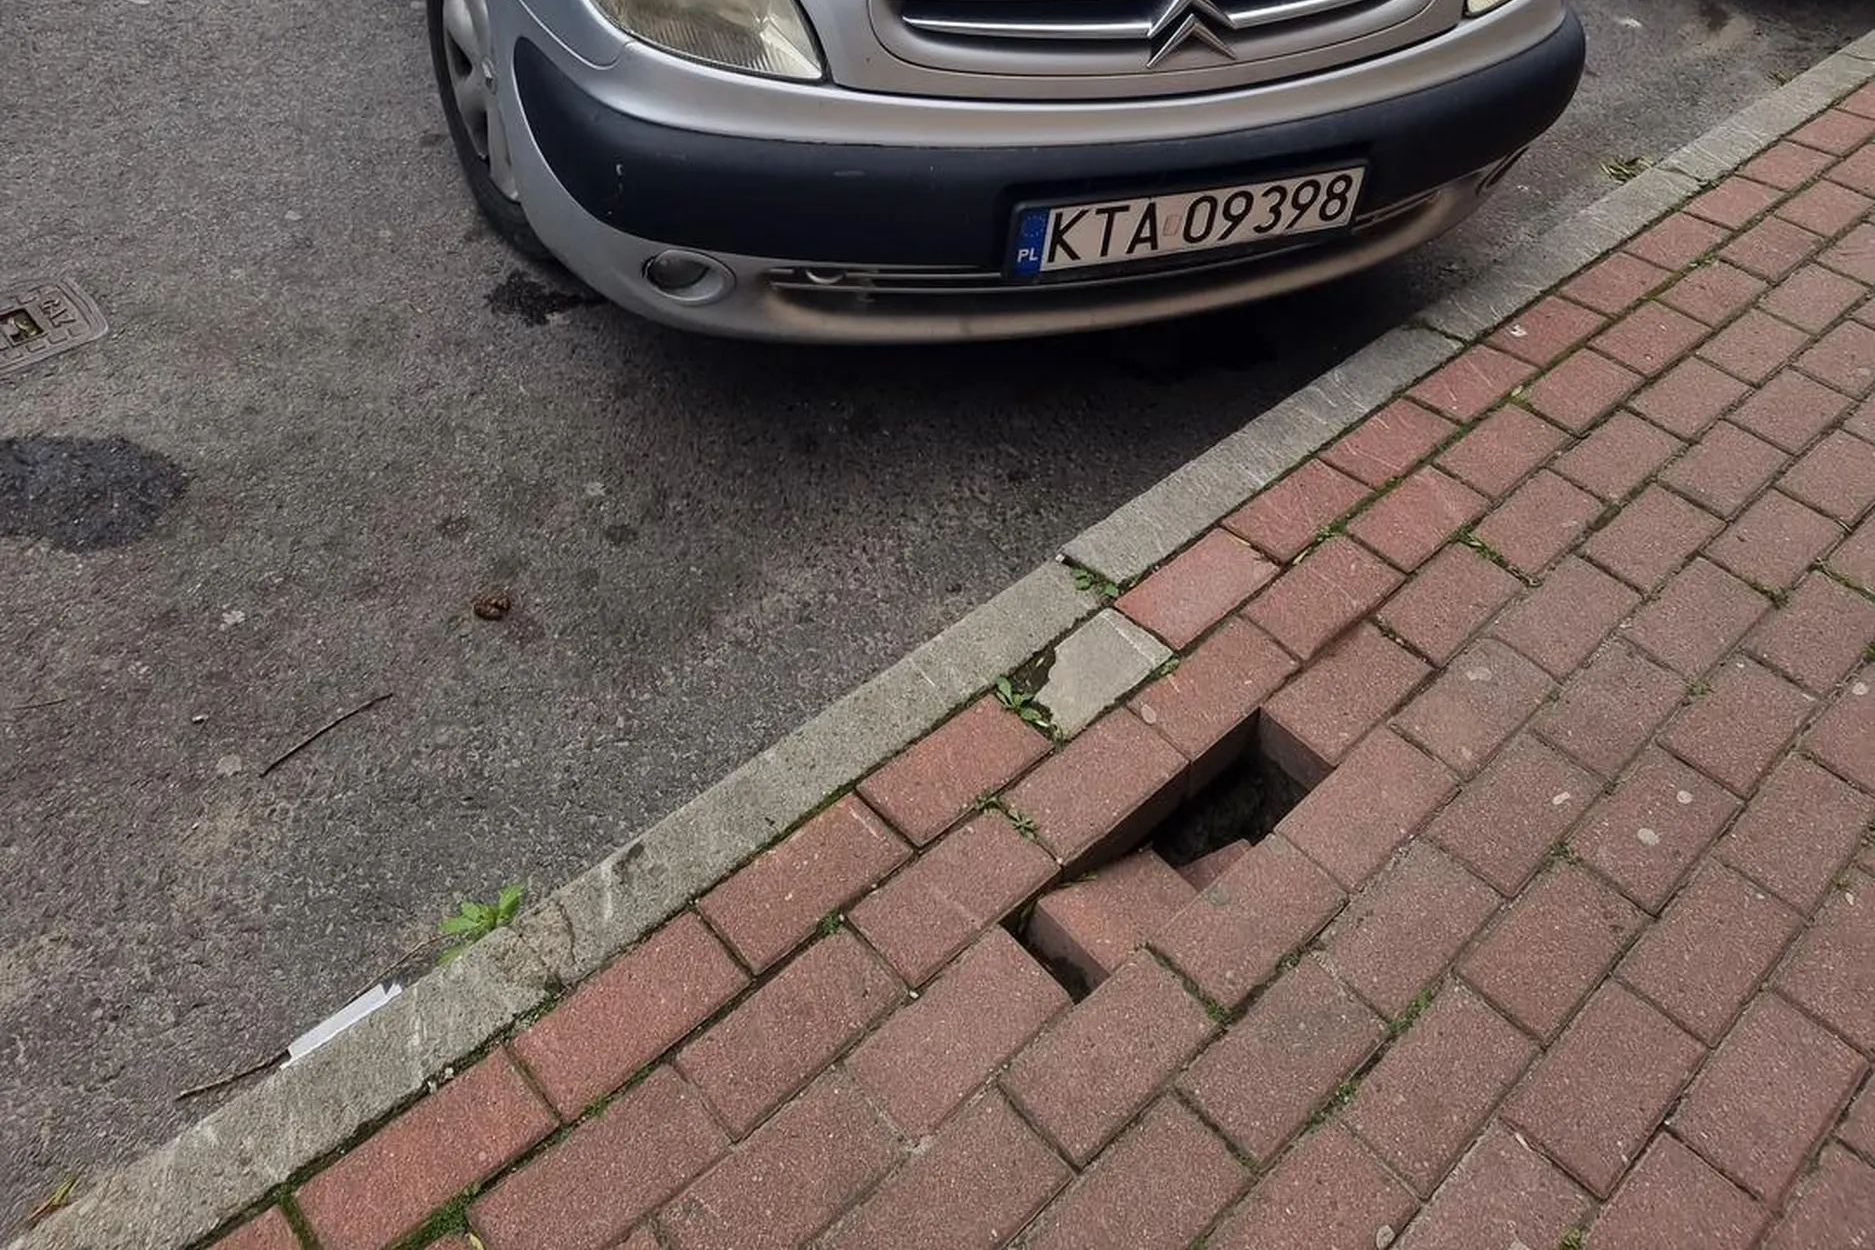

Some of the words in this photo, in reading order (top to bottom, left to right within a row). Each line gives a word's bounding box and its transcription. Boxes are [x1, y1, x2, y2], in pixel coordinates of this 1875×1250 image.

[1047, 203, 1159, 264] KTA
[1182, 174, 1354, 245] 09398
[1016, 249, 1039, 263] PL
